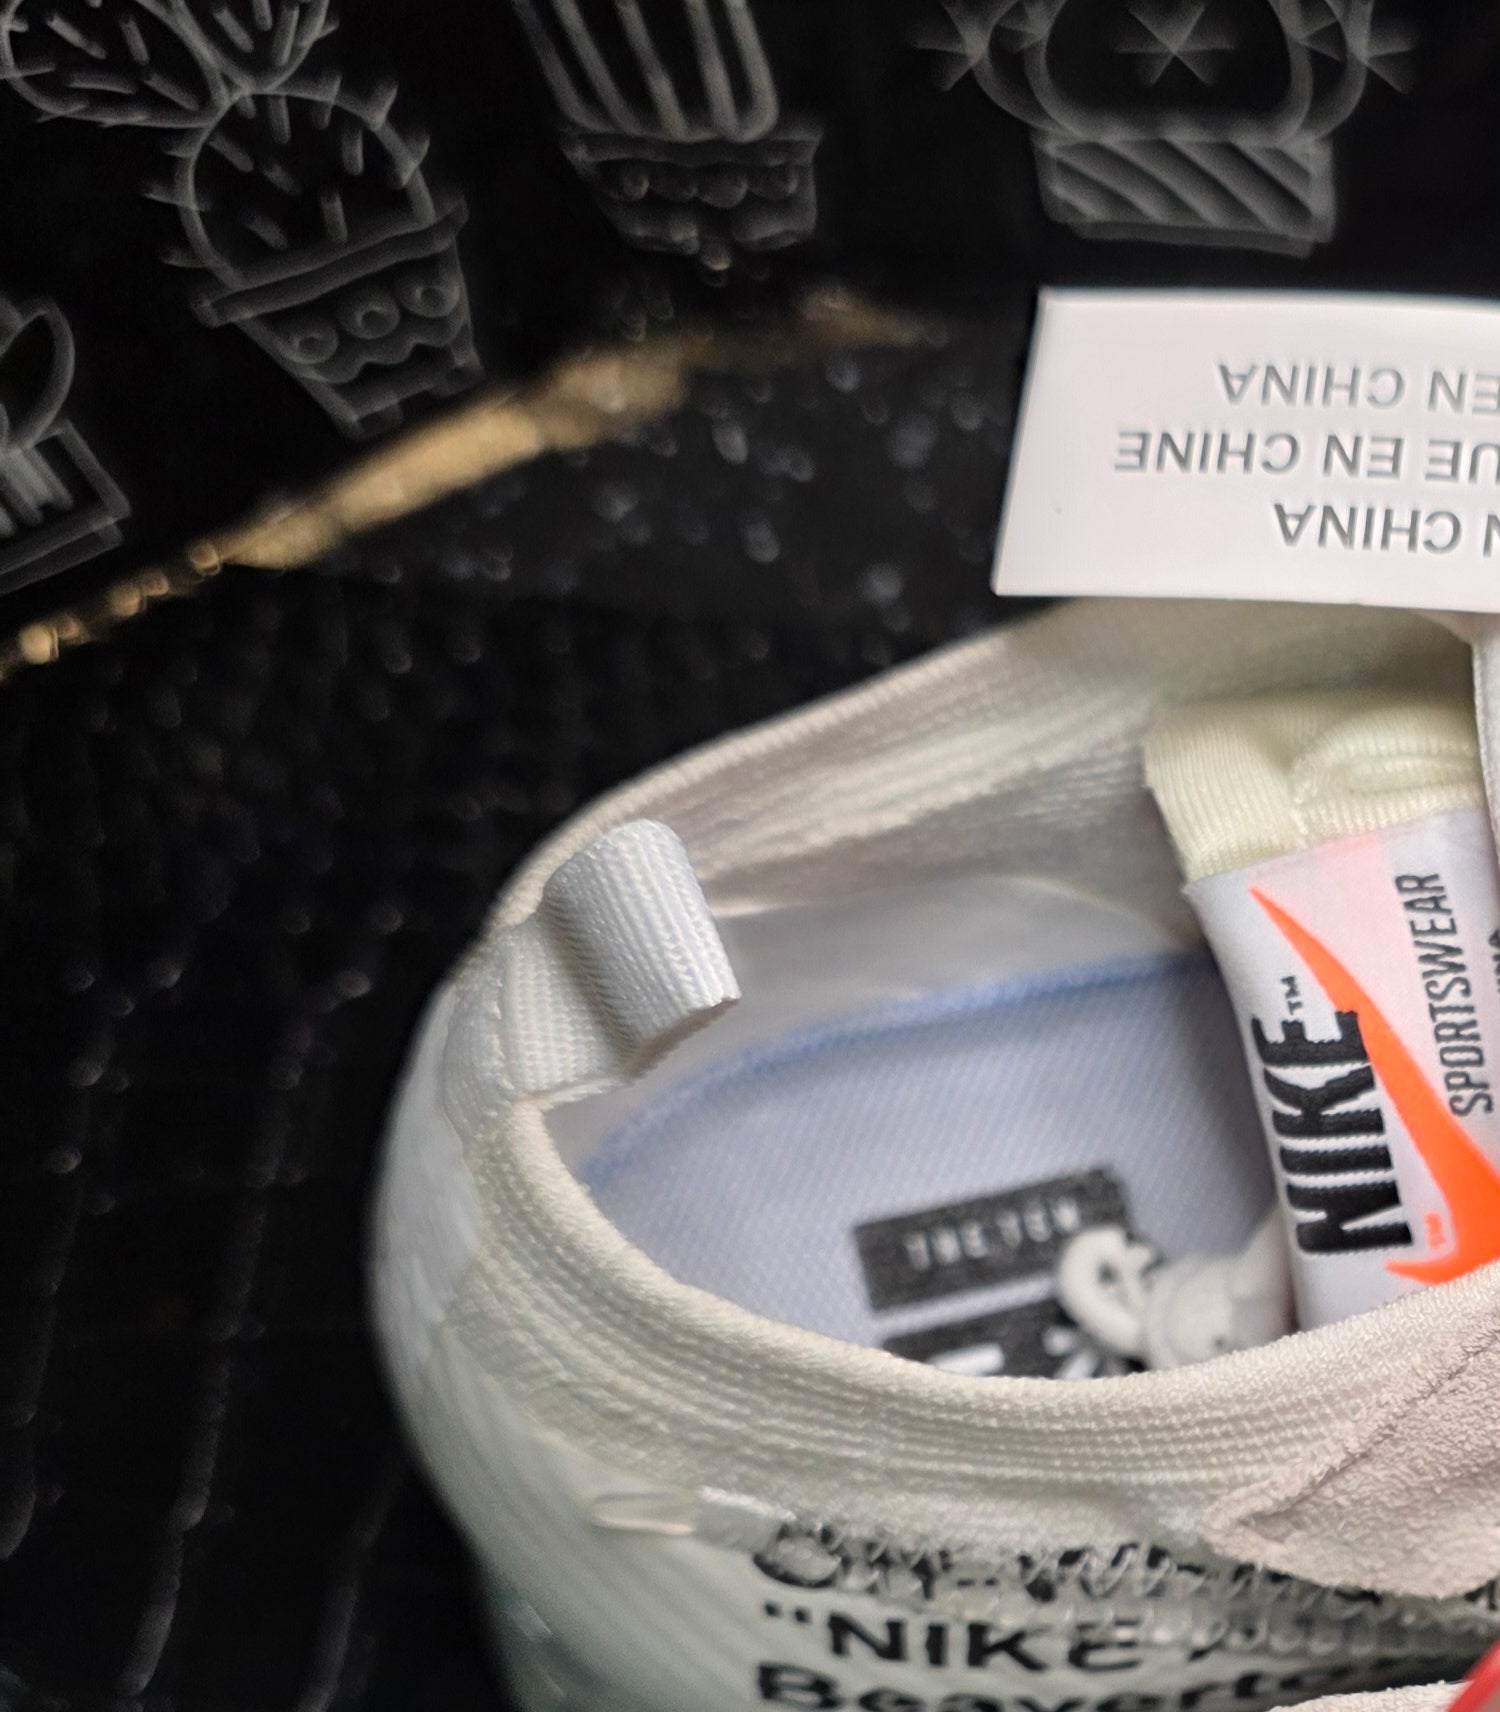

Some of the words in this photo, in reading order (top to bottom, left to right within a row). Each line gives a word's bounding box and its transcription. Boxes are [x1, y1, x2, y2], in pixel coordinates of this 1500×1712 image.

[1217, 362, 1405, 410] CHINA
[1113, 430, 1300, 474] CHINE
[1322, 434, 1403, 478] EN
[1274, 502, 1461, 554] CHINA
[1394, 872, 1494, 1117] SPORTSWEAR
